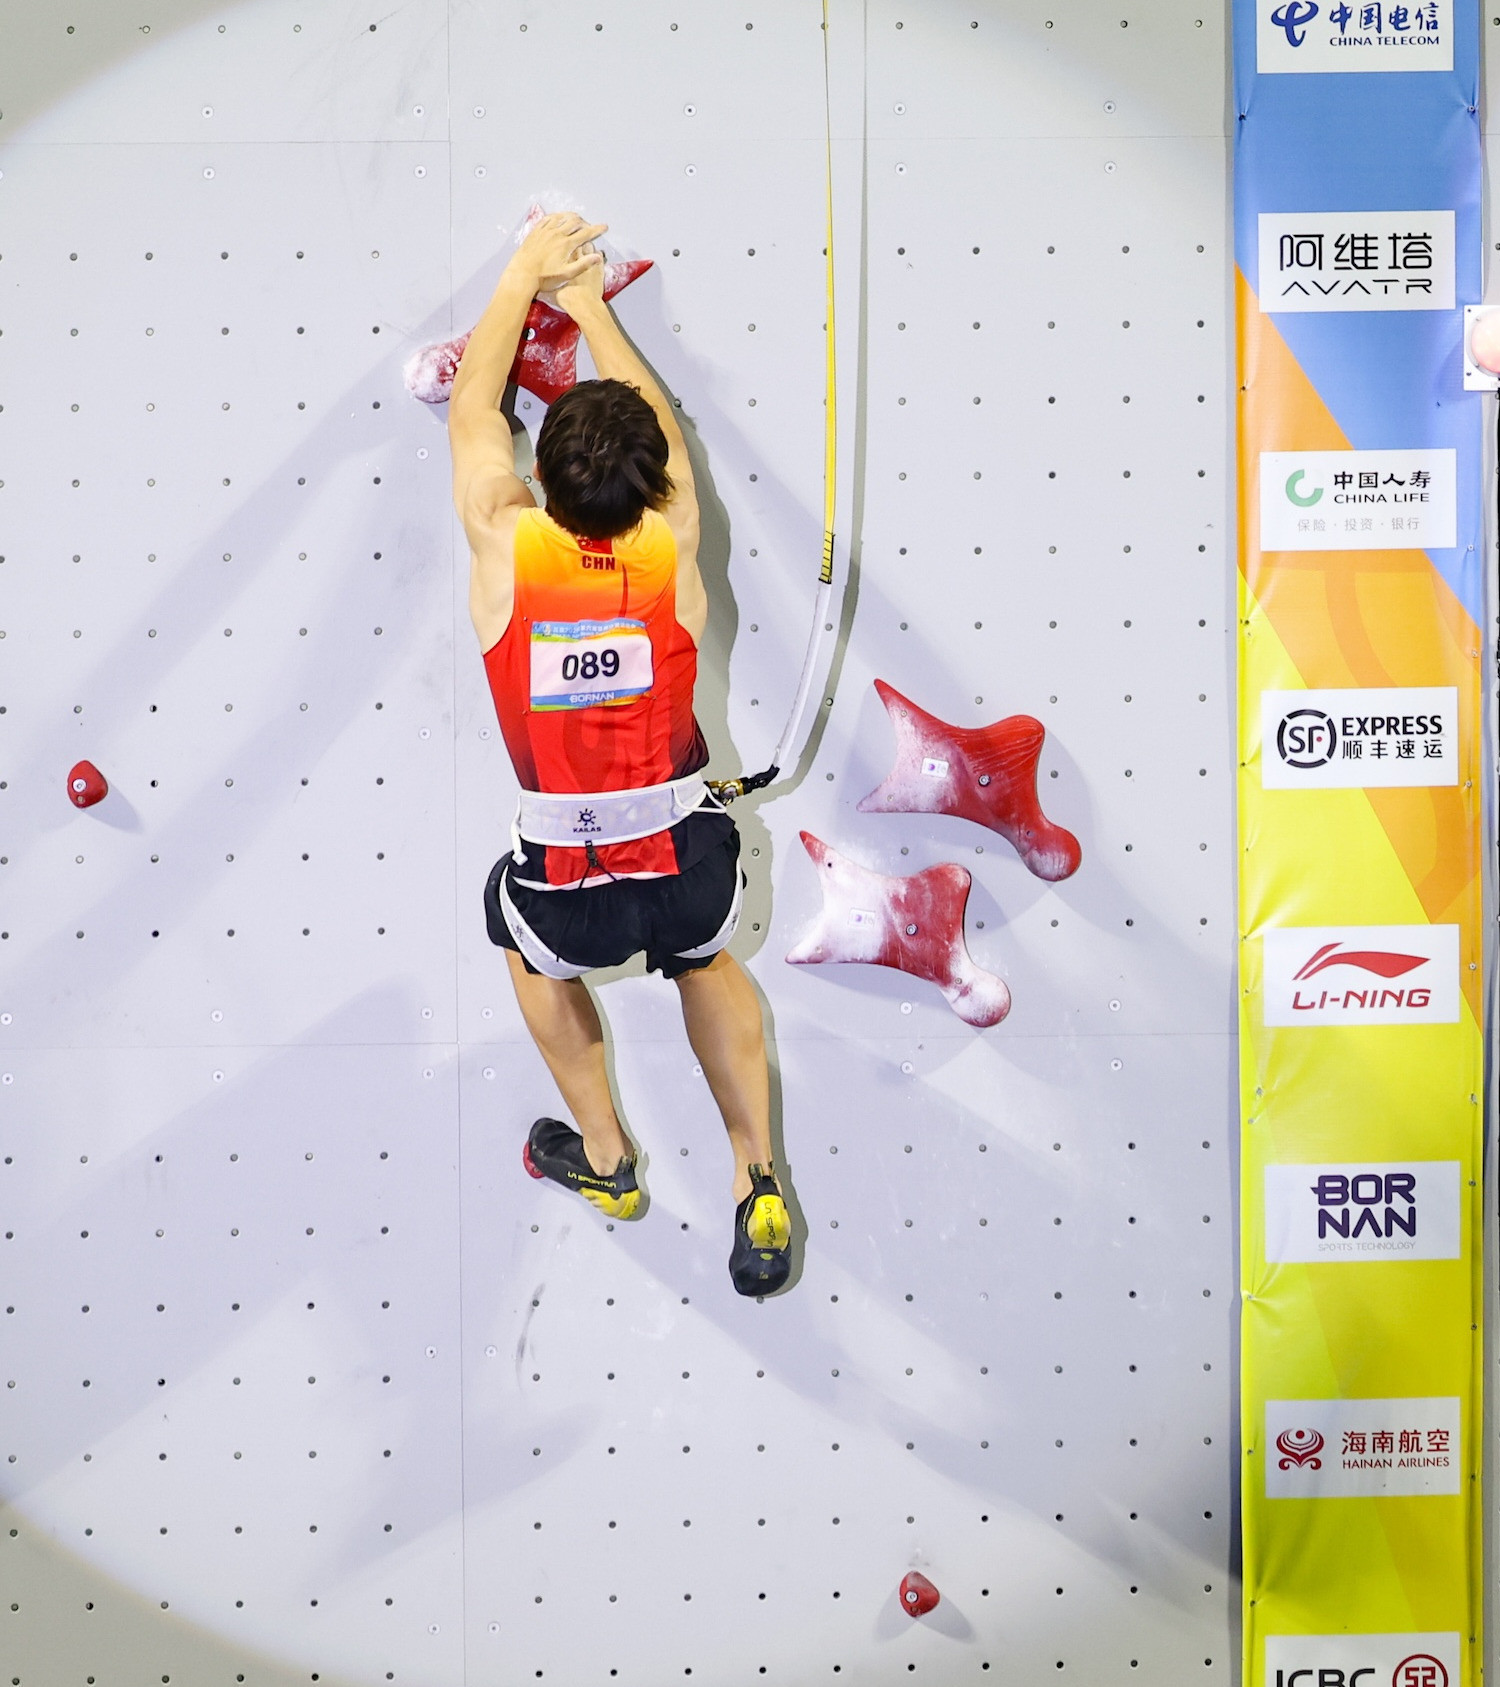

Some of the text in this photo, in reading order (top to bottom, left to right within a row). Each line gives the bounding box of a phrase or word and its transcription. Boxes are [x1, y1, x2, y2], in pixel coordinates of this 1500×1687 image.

[1329, 1, 1440, 35] 中国电信
[1329, 35, 1440, 47] CHINA TELECOM
[1279, 232, 1433, 271] 阿维塔
[1281, 279, 1432, 296] AVATR
[1333, 470, 1431, 490] 中国人寿
[1334, 492, 1430, 504] CHINA LIFE
[581, 555, 616, 570] CHN
[562, 649, 620, 681] 089
[569, 692, 615, 703] BORNAN
[1341, 715, 1443, 736] EXPRESS
[1342, 739, 1443, 759] 顺丰速运
[1292, 988, 1431, 1010] LI-NING
[1310, 1173, 1416, 1206] BOR
[1318, 1206, 1416, 1239] NAN
[1318, 1240, 1417, 1252] SPORTS TECHNOLOGY
[1341, 1429, 1450, 1455] 海南航空
[1342, 1456, 1450, 1469] HAINAN AIRLINES
